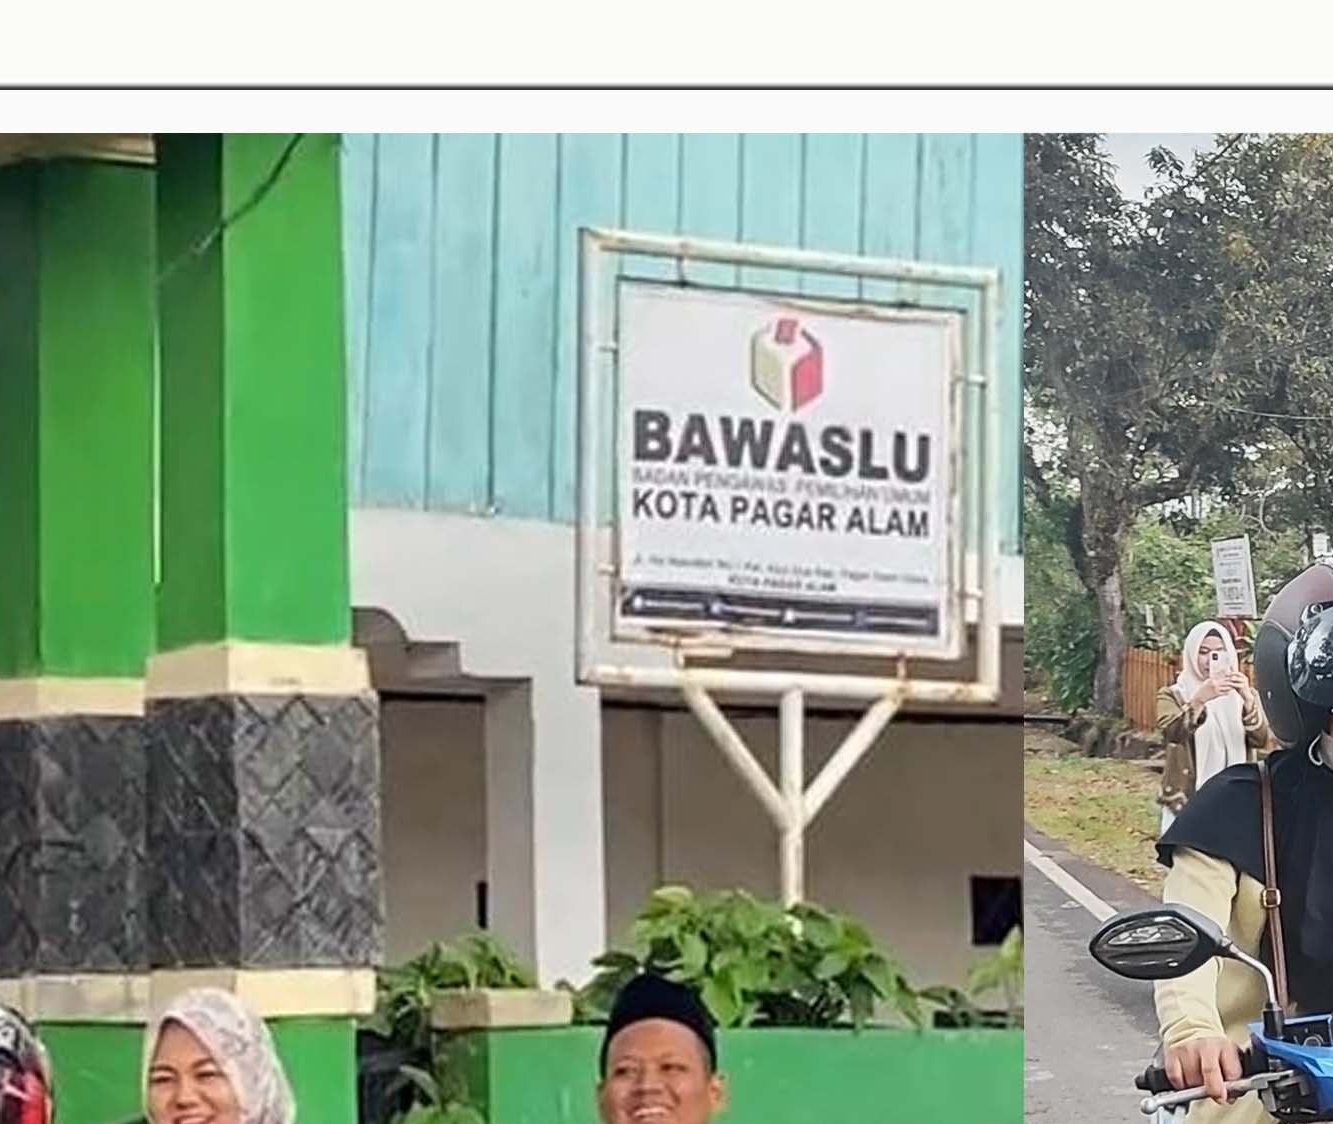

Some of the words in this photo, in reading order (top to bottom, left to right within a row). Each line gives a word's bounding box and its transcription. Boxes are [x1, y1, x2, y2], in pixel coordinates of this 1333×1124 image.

[633, 409, 931, 483] BAWASLU
[632, 466, 689, 487] BADAN
[693, 472, 787, 494] PENGAWAS
[632, 489, 720, 523] KOTA
[730, 496, 837, 531] PAGAR
[845, 506, 930, 537] ALAM
